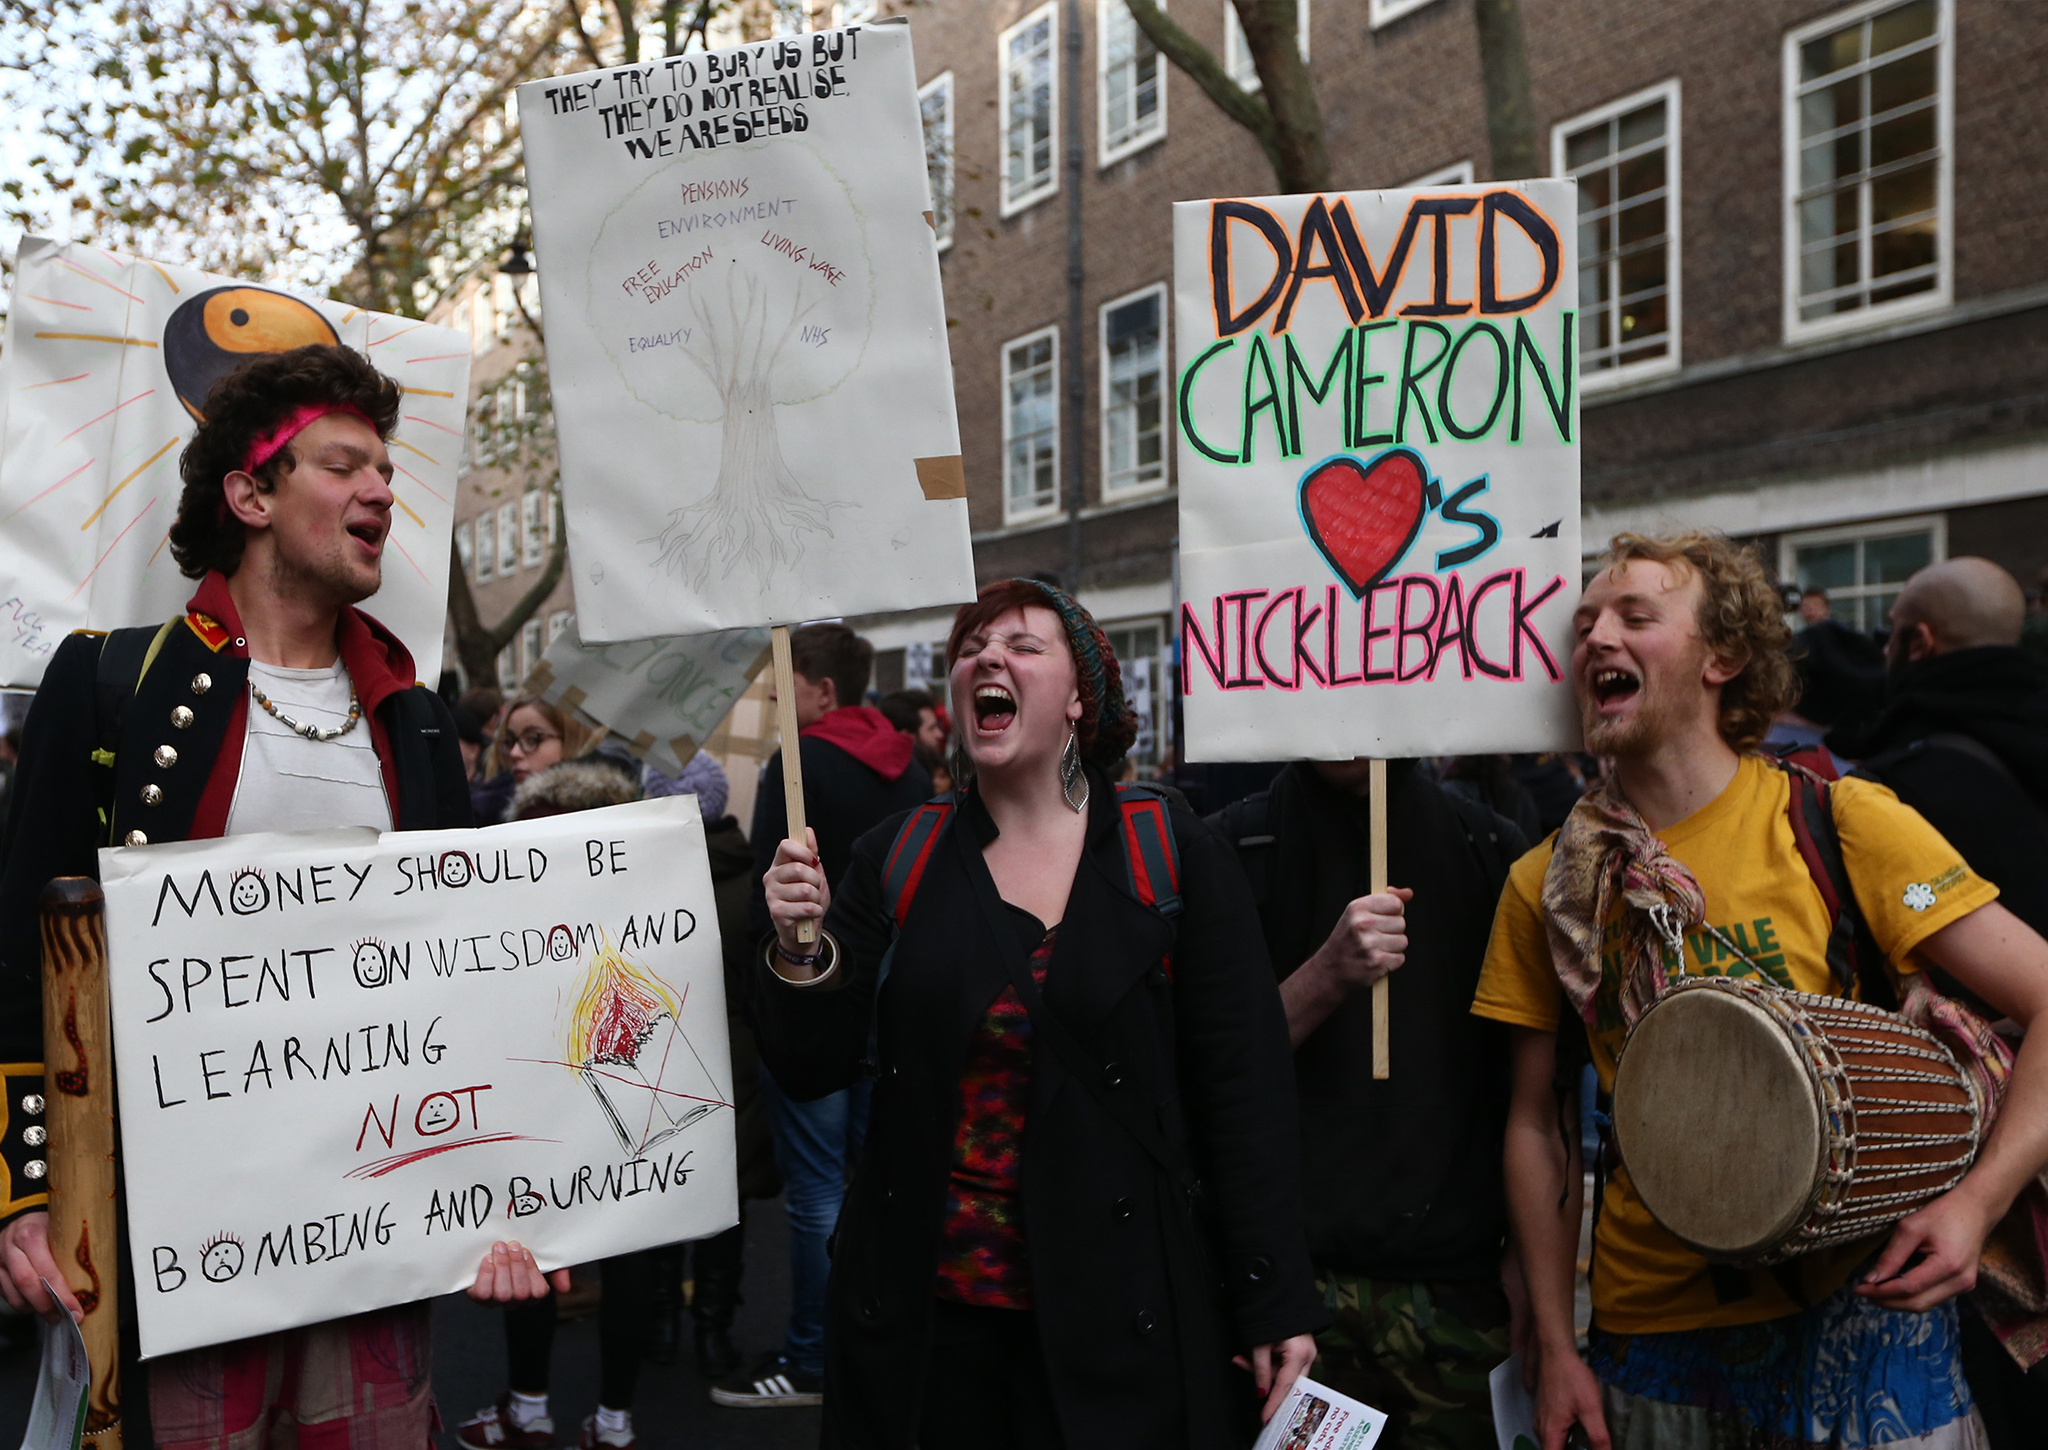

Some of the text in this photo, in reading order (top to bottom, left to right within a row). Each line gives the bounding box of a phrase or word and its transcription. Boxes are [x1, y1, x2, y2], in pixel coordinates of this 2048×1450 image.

[545, 27, 861, 114] THEY TRY TO BURY US BUT
[599, 97, 657, 138] THEY
[663, 93, 692, 123] DO
[702, 82, 743, 111] NOT
[624, 103, 809, 159] WE ARE SEEDS
[658, 198, 797, 238] ENVIRONMENT
[681, 177, 749, 205] PENSIONS
[622, 259, 661, 296] FREE
[643, 245, 713, 304] EDUCATION
[761, 229, 846, 287] LIVING WAGE
[1207, 188, 1563, 338] DAVID
[629, 328, 692, 353] EQUALITY
[800, 325, 831, 348] NHS
[1178, 310, 1579, 466] CAMERON
[12, 625, 57, 660] YEA
[1180, 568, 1566, 695] NICKLEBACK
[152, 838, 629, 927] MONEY SHOULD BE
[146, 908, 697, 1024] SPENT ON WISDOM AND
[1688, 917, 1780, 965] VALE
[152, 1016, 448, 1108] LEARNING
[355, 1085, 492, 1151] NOT
[152, 1152, 695, 1292] BOMBING AND BURNING
[1334, 1411, 1350, 1433] Free
